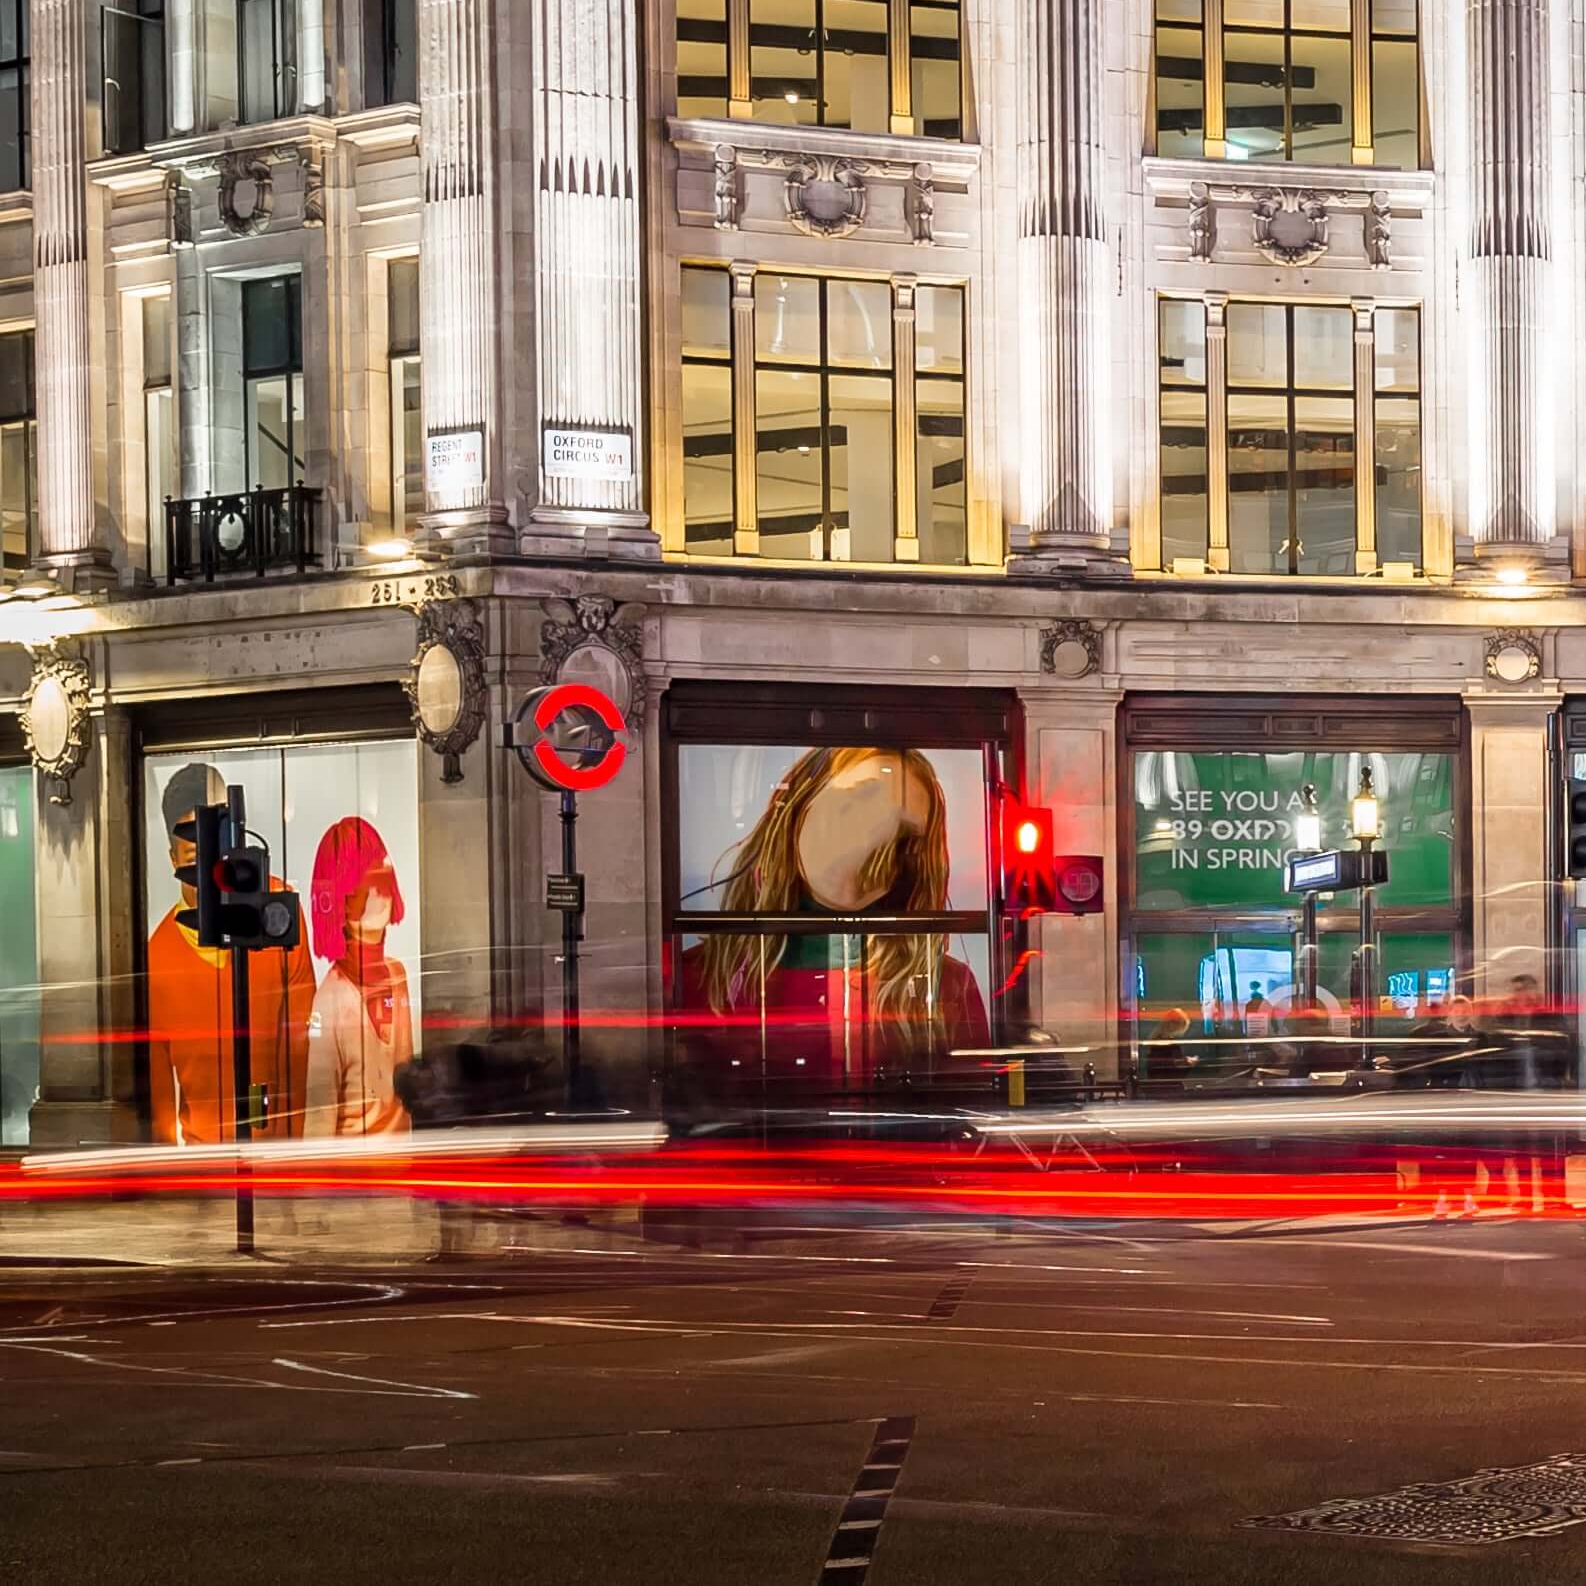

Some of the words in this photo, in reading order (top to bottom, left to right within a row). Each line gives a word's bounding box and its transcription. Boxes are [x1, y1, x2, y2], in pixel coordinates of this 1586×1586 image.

[553, 435, 603, 450] OXFORD
[553, 449, 600, 463] CIRCUS
[605, 453, 623, 465] W1
[1170, 790, 1213, 812] SEE
[1219, 790, 1278, 812] YOU
[1172, 819, 1203, 841] 89
[1171, 848, 1199, 869] IN
